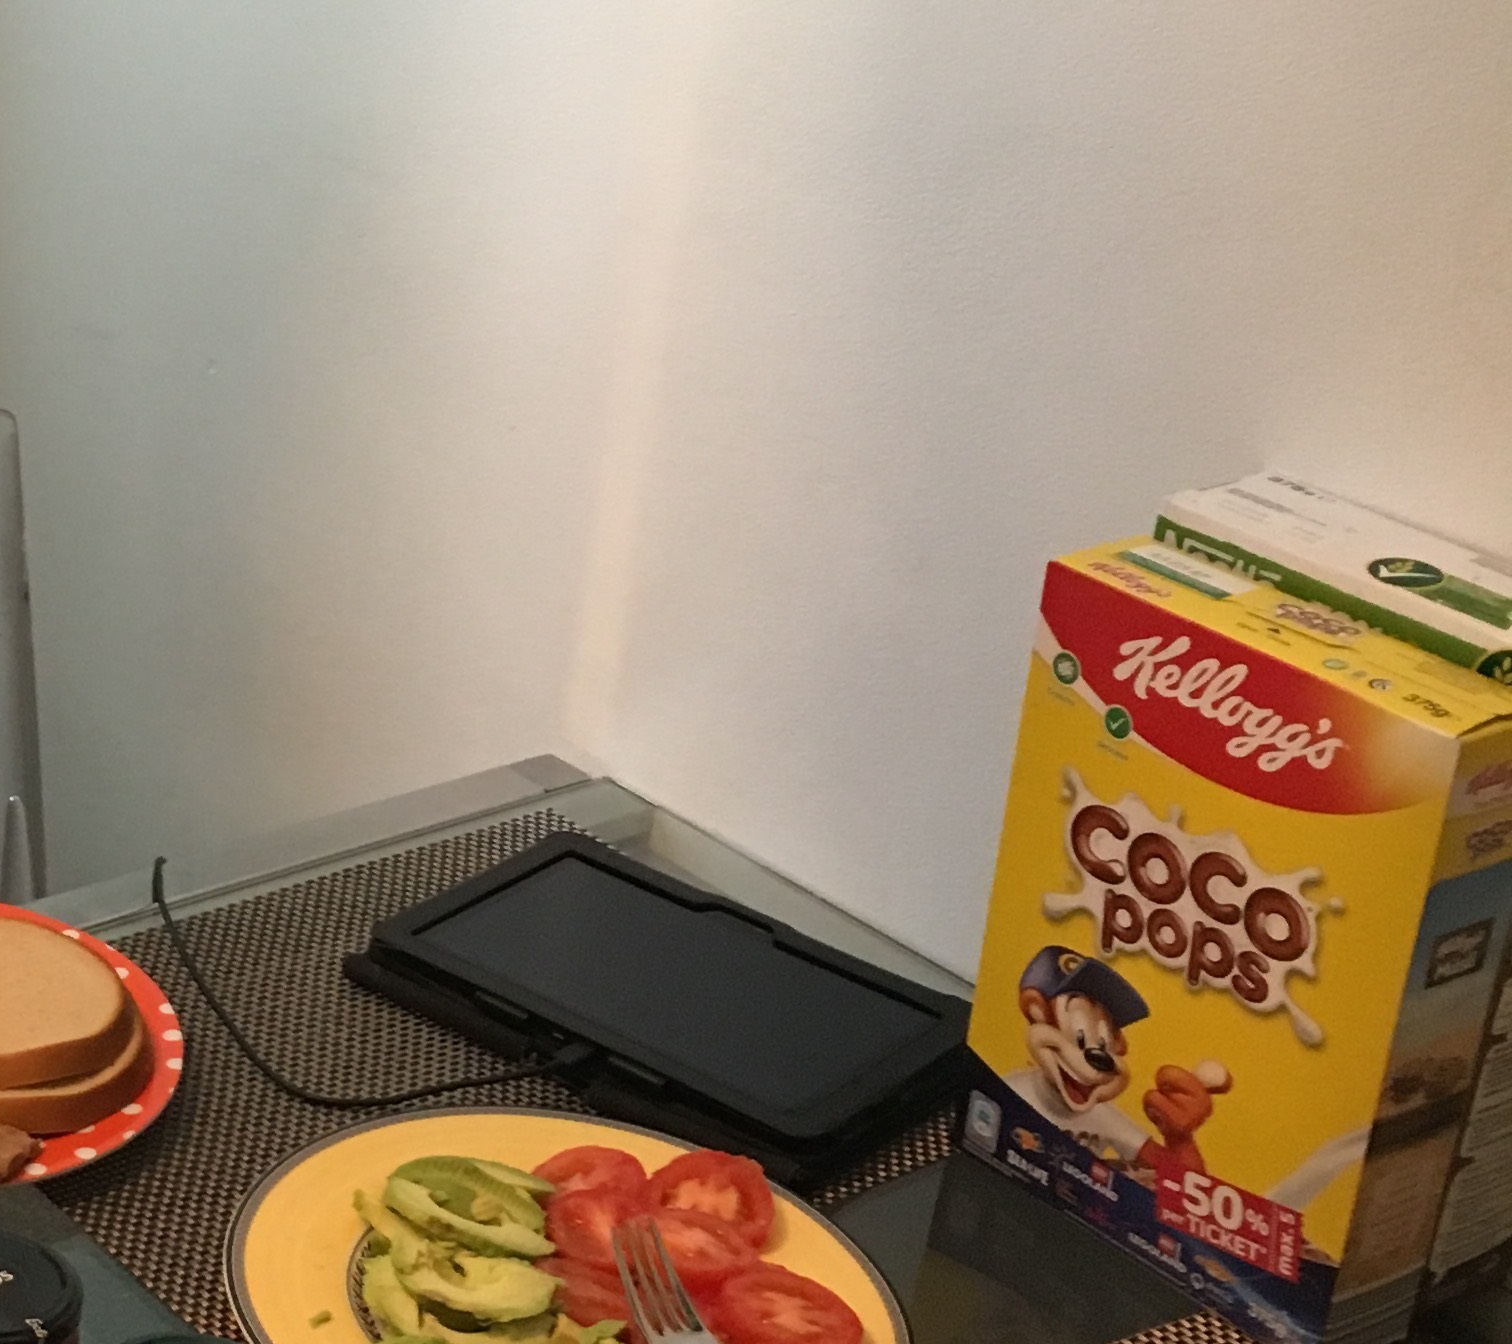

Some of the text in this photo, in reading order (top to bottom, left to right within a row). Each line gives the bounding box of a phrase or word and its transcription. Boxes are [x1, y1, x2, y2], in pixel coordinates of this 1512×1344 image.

[1113, 635, 1343, 772] Kellogg's
[1070, 804, 1311, 962] COCO
[1101, 888, 1271, 1014] pops
